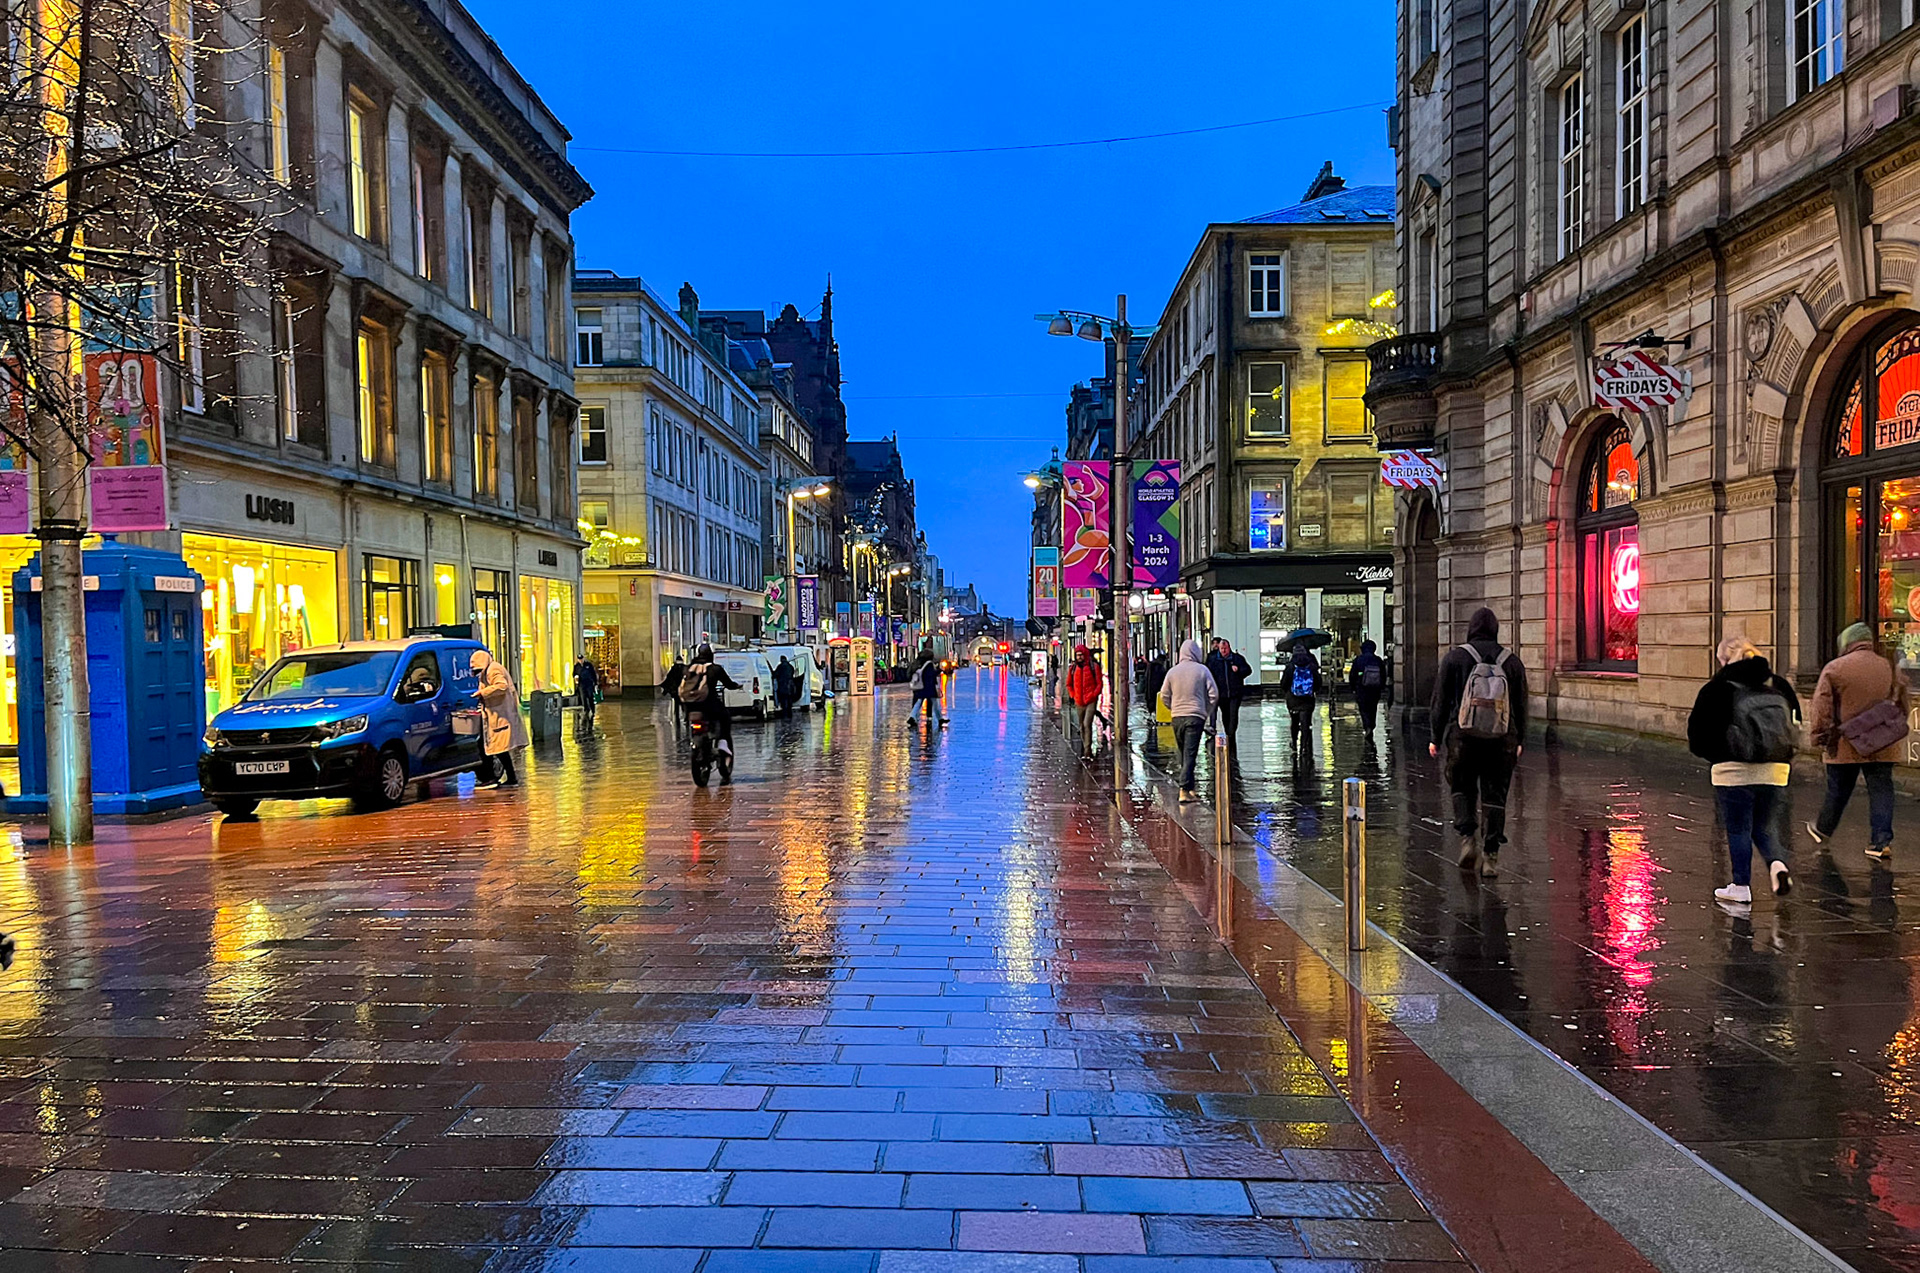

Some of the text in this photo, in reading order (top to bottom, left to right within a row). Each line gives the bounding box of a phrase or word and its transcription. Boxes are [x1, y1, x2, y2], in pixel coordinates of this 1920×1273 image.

[246, 494, 294, 525] LUSH
[1149, 534, 1163, 543] 1-3
[1142, 545, 1170, 554] March
[1144, 557, 1168, 565] 2024
[1039, 568, 1053, 582] 20
[1355, 565, 1393, 581] Kiehl's
[160, 579, 191, 590] POLICE
[240, 763, 264, 773] YC70
